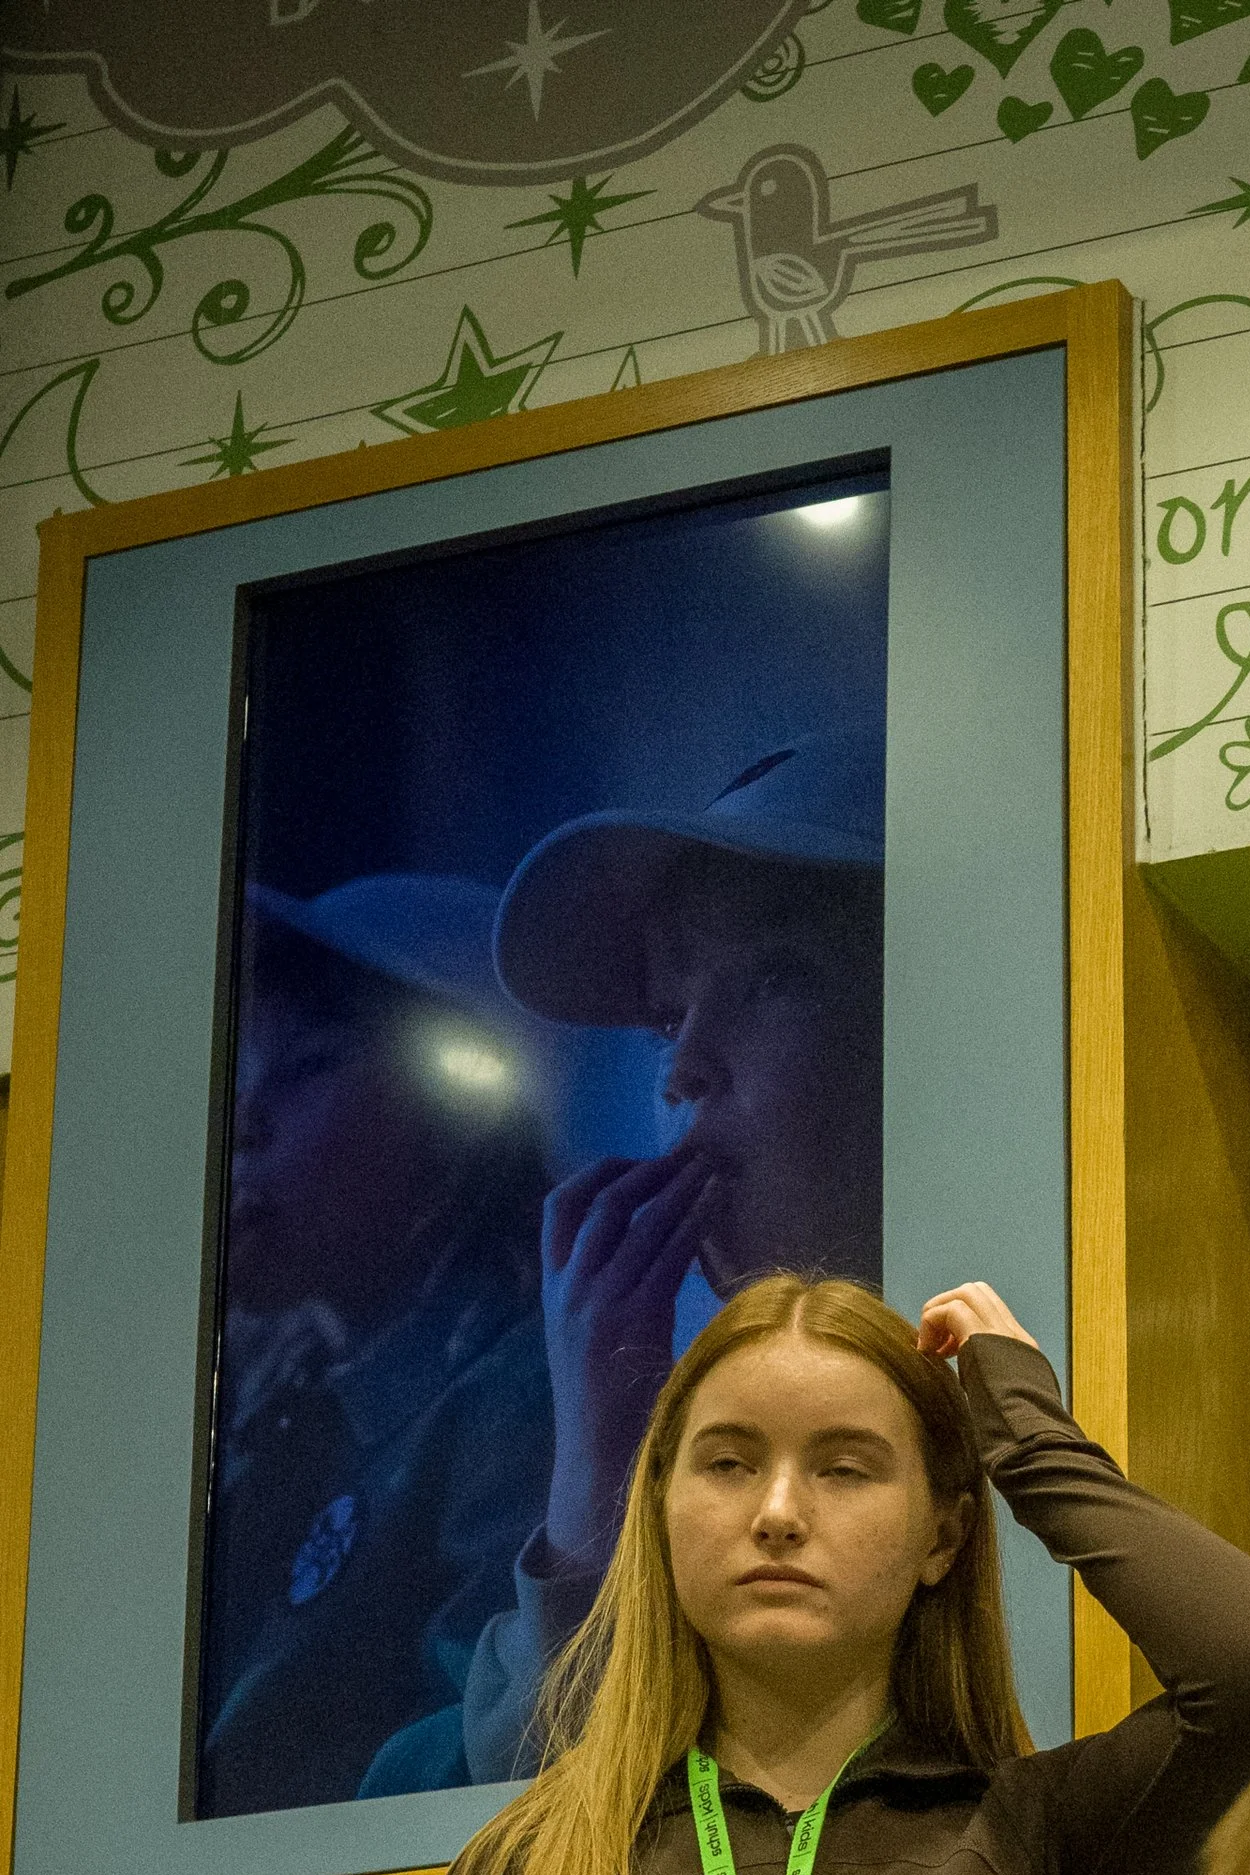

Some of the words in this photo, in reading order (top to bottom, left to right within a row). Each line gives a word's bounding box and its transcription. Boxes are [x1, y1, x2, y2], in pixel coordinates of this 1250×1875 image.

[698, 1783, 714, 1816] kids
[705, 1819, 722, 1857] schuh
[797, 1818, 816, 1852] kids
